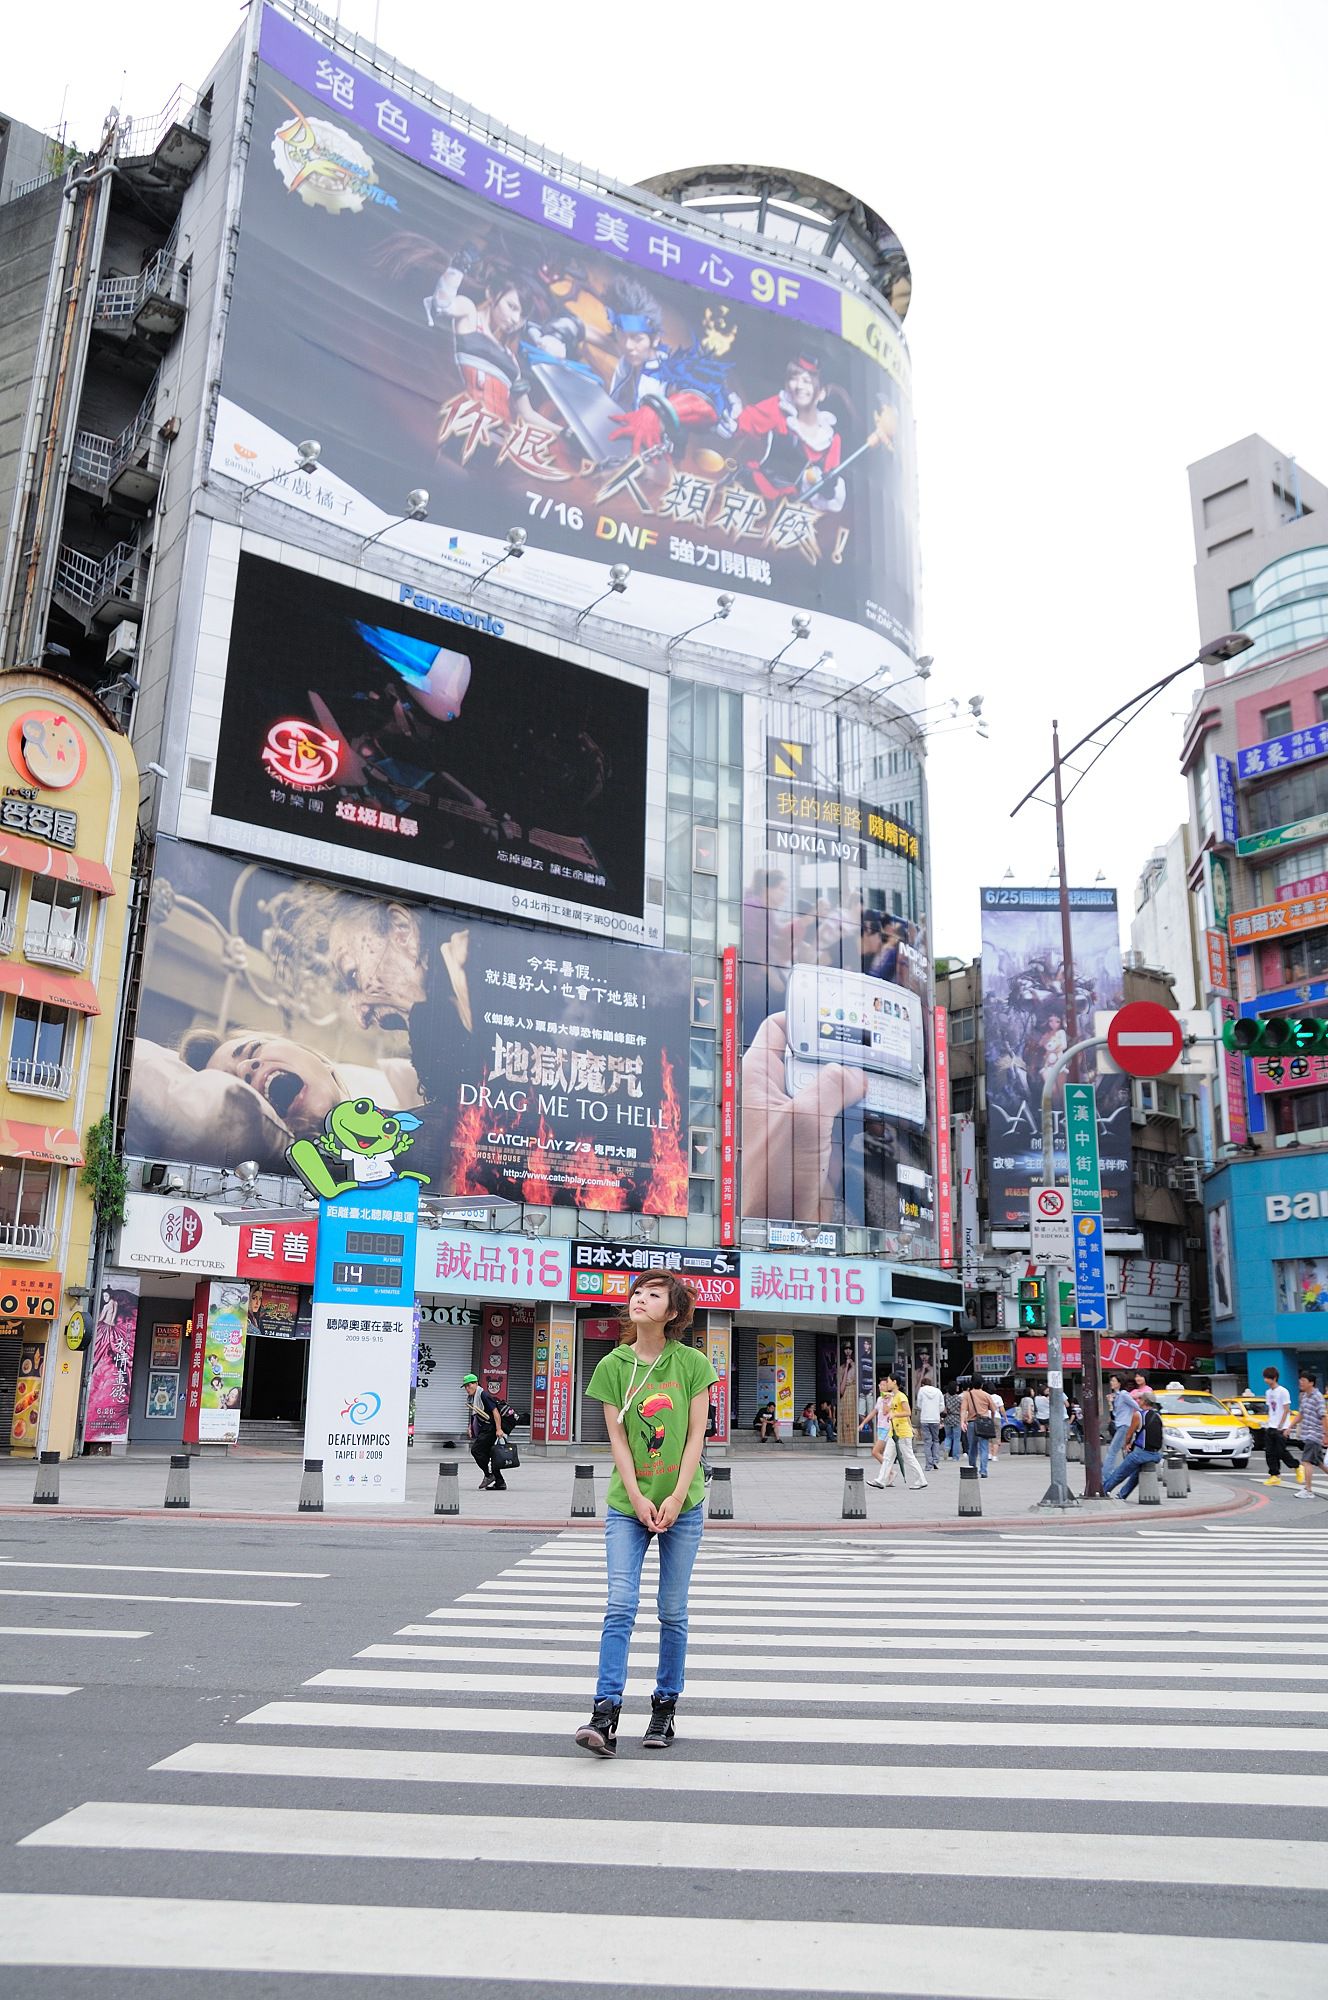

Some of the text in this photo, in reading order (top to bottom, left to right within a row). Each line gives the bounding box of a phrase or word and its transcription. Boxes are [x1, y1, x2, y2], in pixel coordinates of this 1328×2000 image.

[316, 59, 800, 307] 絕色整形醫美中心 9F
[525, 491, 772, 586] 7/16 DNF 強力開戰
[400, 583, 505, 637] Panasonic
[264, 765, 337, 793] MATERIAL
[335, 800, 419, 838] 垃圾風暴
[777, 791, 862, 833] 我的網路
[777, 831, 860, 862] NOKIA N97
[496, 849, 544, 872] 忘掉過去
[488, 1032, 644, 1099] 地獄魔咒
[460, 1083, 668, 1130] DRAG ME TO HELL
[487, 1132, 637, 1159] CATCHPLAY 7/3 鬼門大開
[1073, 1105, 1092, 1172] 漢中街
[498, 1152, 521, 1163] HOUSE
[503, 1168, 620, 1188] http://www.catchplay.com/hell
[1072, 1177, 1088, 1186] Han
[1072, 1187, 1099, 1198] Zhong
[1073, 1199, 1086, 1207] St.
[326, 1204, 415, 1224] 距離臺北聽障奧運
[247, 1227, 309, 1263] 真善
[130, 1252, 225, 1270] CENTRAL PICTURES
[435, 1240, 563, 1288] 誠品116
[713, 1254, 735, 1274] 5F
[1078, 1237, 1089, 1282] 服務中心
[344, 1265, 363, 1284] 14
[751, 1264, 865, 1305] 誠品116
[26, 1296, 55, 1316] YA
[697, 1293, 722, 1303] APAN
[326, 1318, 404, 1333] 聽障奧運在臺北
[421, 1305, 471, 1326] oots
[328, 1433, 390, 1446] DEAFLYMPICS
[335, 1450, 383, 1460] TAIPEI 2009
